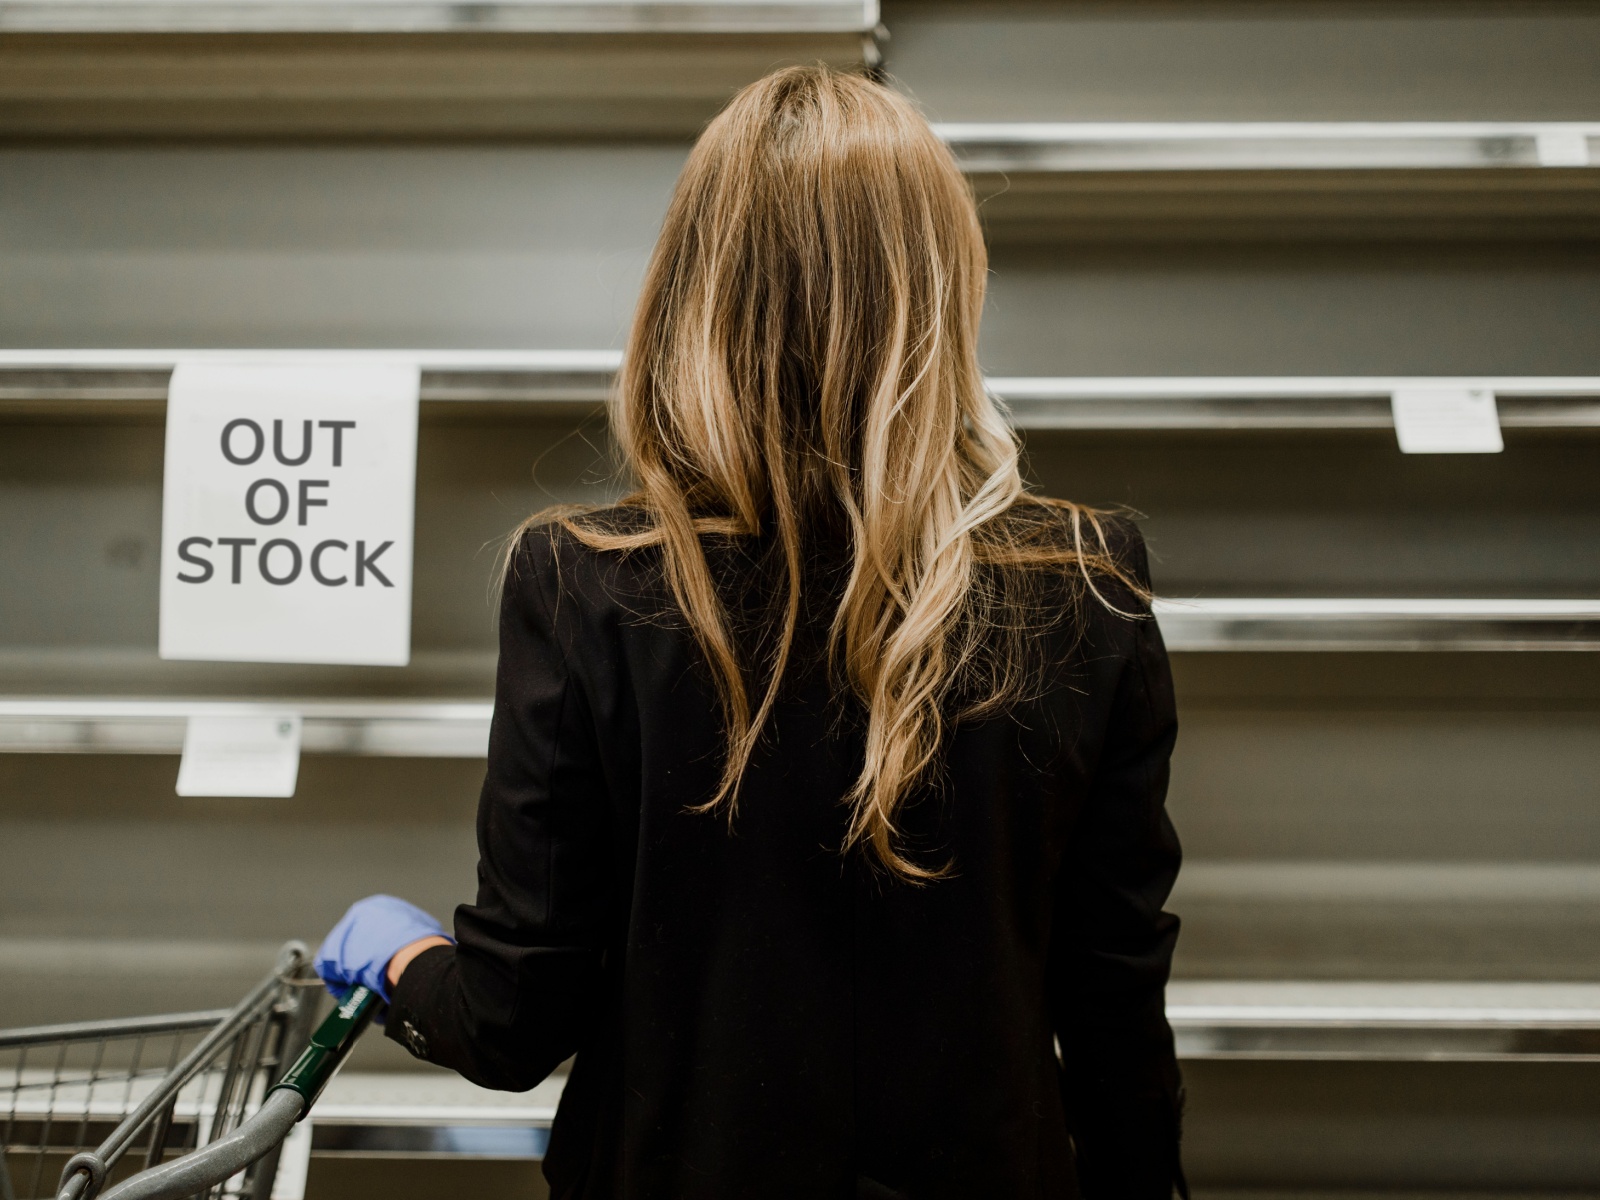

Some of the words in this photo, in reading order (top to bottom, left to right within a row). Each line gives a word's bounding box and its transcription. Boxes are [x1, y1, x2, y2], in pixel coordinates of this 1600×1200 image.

[220, 418, 356, 467] OUT
[245, 478, 330, 526] OF
[176, 536, 395, 588] STOCK
